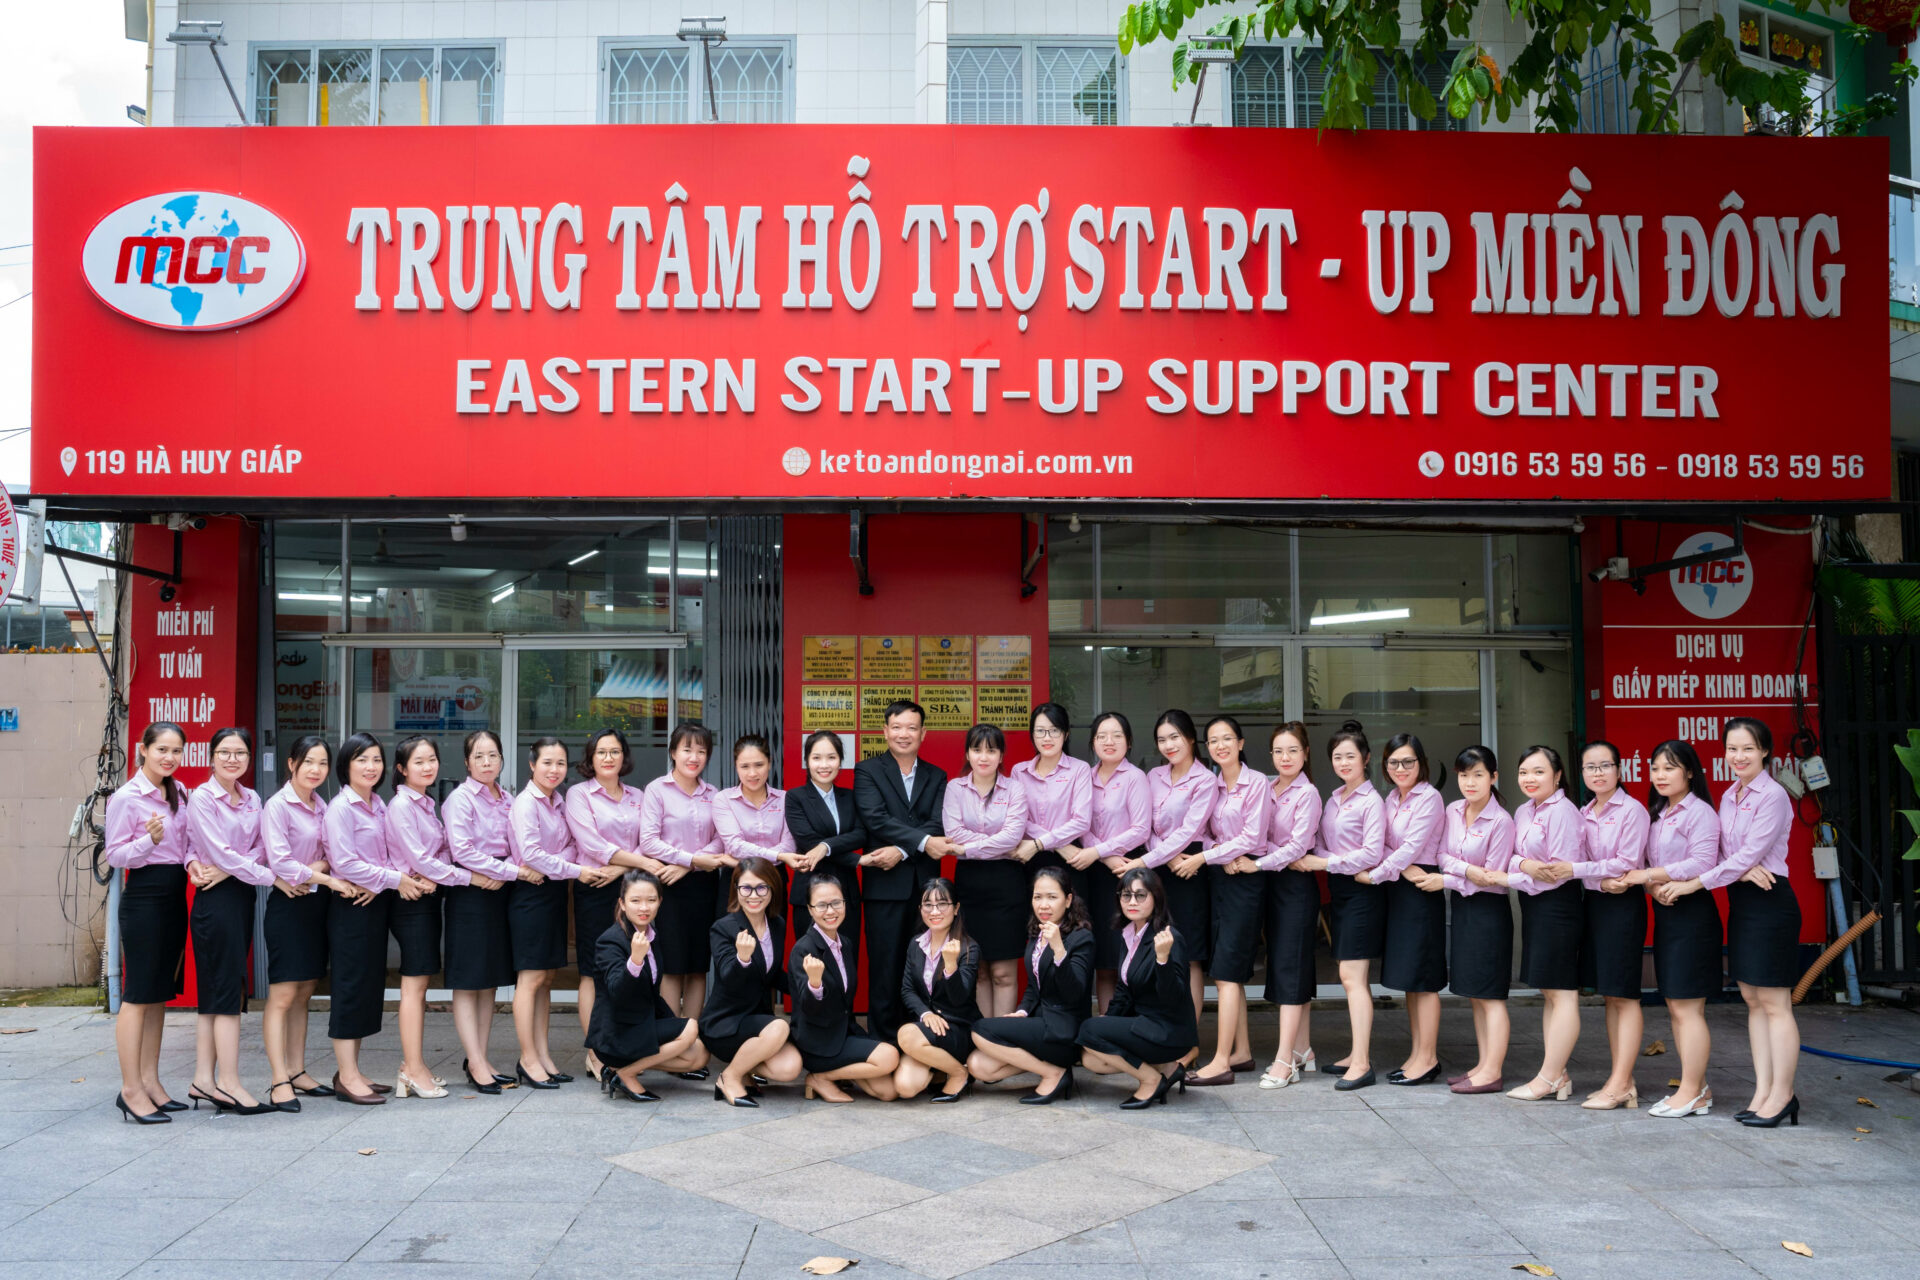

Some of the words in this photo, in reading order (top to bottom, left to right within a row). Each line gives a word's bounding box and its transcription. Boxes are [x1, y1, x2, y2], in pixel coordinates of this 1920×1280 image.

[346, 202, 588, 310] TRUNG
[607, 181, 762, 310] TÂM
[782, 155, 881, 310] HỖ
[902, 186, 1050, 331] TRỢ
[1064, 204, 1298, 311] START
[1319, 258, 1342, 278] -
[1361, 210, 1451, 313] UP
[1471, 167, 1643, 315] MIỀN
[1663, 190, 1845, 317] ĐÔNG
[456, 357, 756, 413] EASTERN
[781, 356, 1124, 414] START-UP
[1146, 358, 1450, 415] SUPPORT
[1474, 361, 1720, 418] CENTER
[85, 450, 126, 474] 119
[136, 445, 172, 474] HÀ
[182, 449, 232, 474] HUY
[241, 444, 303, 474] GIÁP
[819, 449, 1134, 478] ketoandongnai.com.vn
[1454, 452, 1518, 476] 0916
[1528, 452, 1560, 477] 53
[1571, 453, 1603, 477] 59
[1614, 453, 1646, 477] 56
[1677, 454, 1738, 478] 0918
[1748, 454, 1779, 478] 53
[1789, 454, 1821, 478] 59
[1832, 455, 1864, 479] 56
[1, 537, 17, 569] THUẾ
[157, 602, 190, 636] MIỄN
[193, 605, 214, 636] PHÍ
[159, 650, 176, 679] TƯ
[178, 646, 202, 679] VẤN
[1676, 634, 1716, 662] DỊCH
[1722, 634, 1744, 662] VỤ
[1612, 667, 1651, 699] GIẤY
[1656, 670, 1700, 699] PHÉP
[1705, 674, 1746, 698] KINH
[1751, 674, 1808, 698] DOANH
[149, 693, 189, 723] THÀNH
[192, 692, 216, 727] LẬP
[929, 704, 961, 713] SBA
[981, 704, 1003, 714] THÀNH
[1005, 702, 1028, 714] THẮNG
[1678, 716, 1719, 745] DỊCH
[1620, 749, 1642, 783] KẾ
